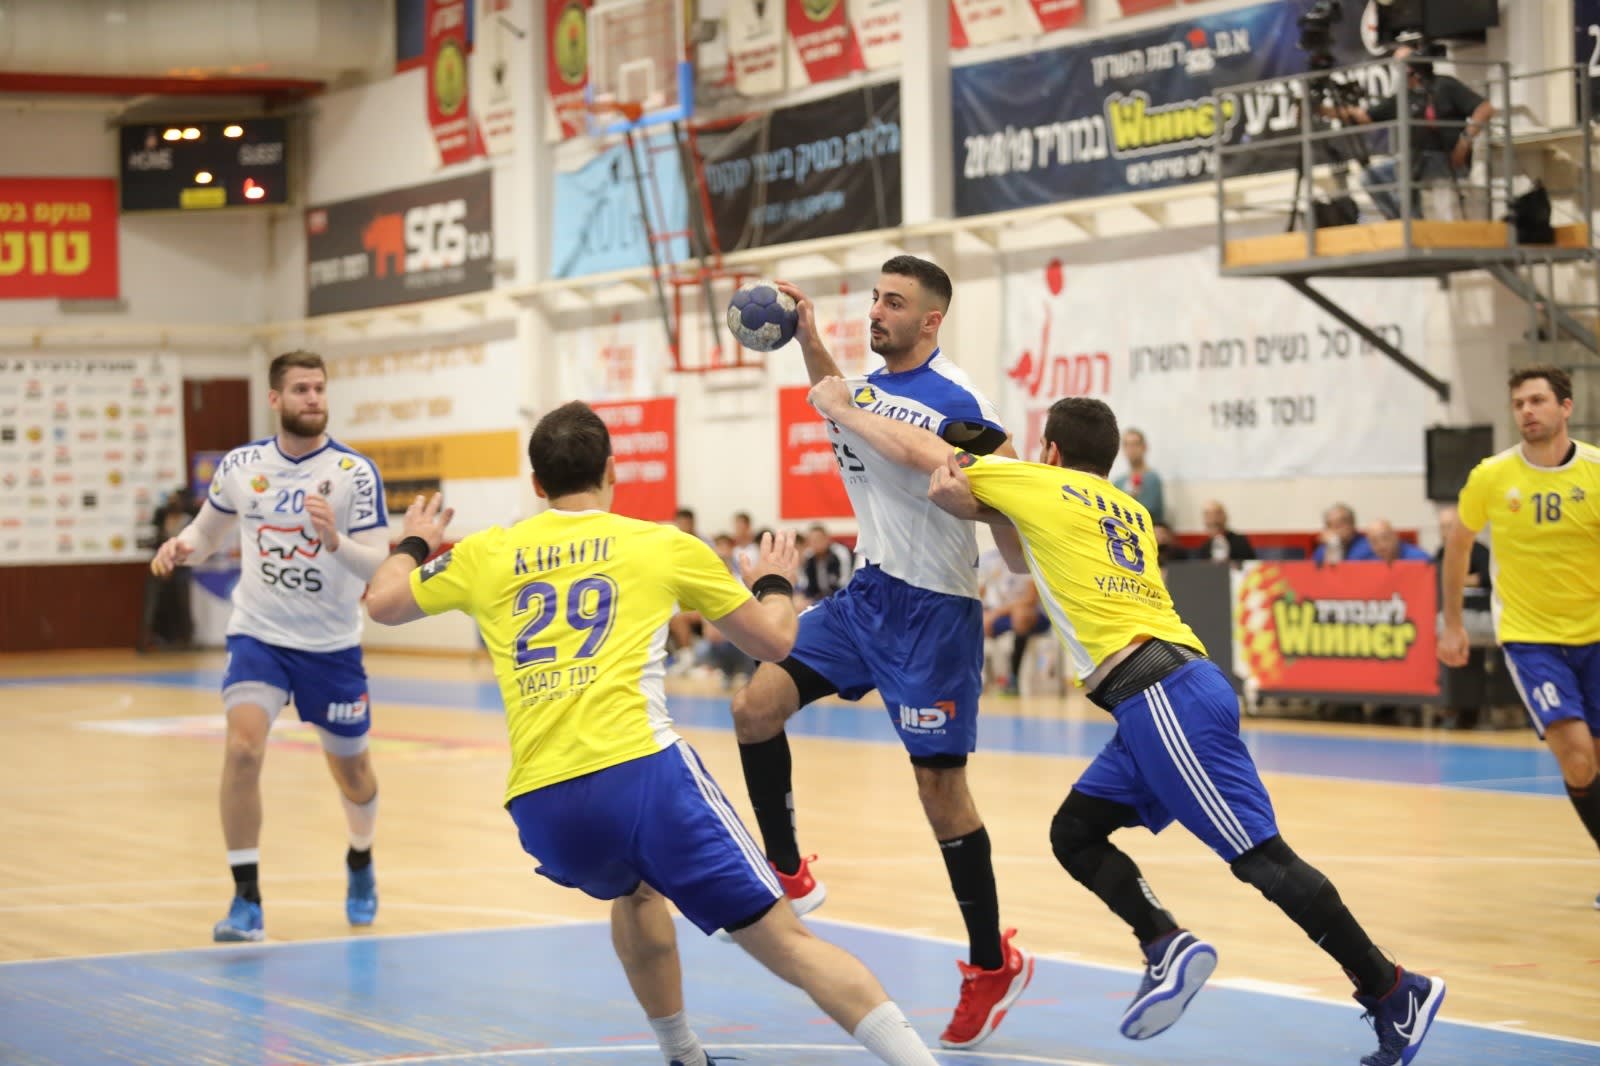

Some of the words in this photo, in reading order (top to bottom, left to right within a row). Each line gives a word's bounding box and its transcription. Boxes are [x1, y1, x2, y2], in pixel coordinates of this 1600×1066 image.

[1128, 343, 1191, 382] השרון
[1198, 338, 1247, 370] רמת
[1254, 332, 1310, 366] נשים
[273, 488, 306, 515] 20
[353, 465, 375, 522] VARTA
[1531, 491, 1563, 525] 18
[1098, 515, 1146, 577] 8
[261, 562, 323, 593] SGS
[512, 573, 619, 671] 29
[1273, 599, 1417, 660] Winner
[1532, 681, 1562, 712] 18
